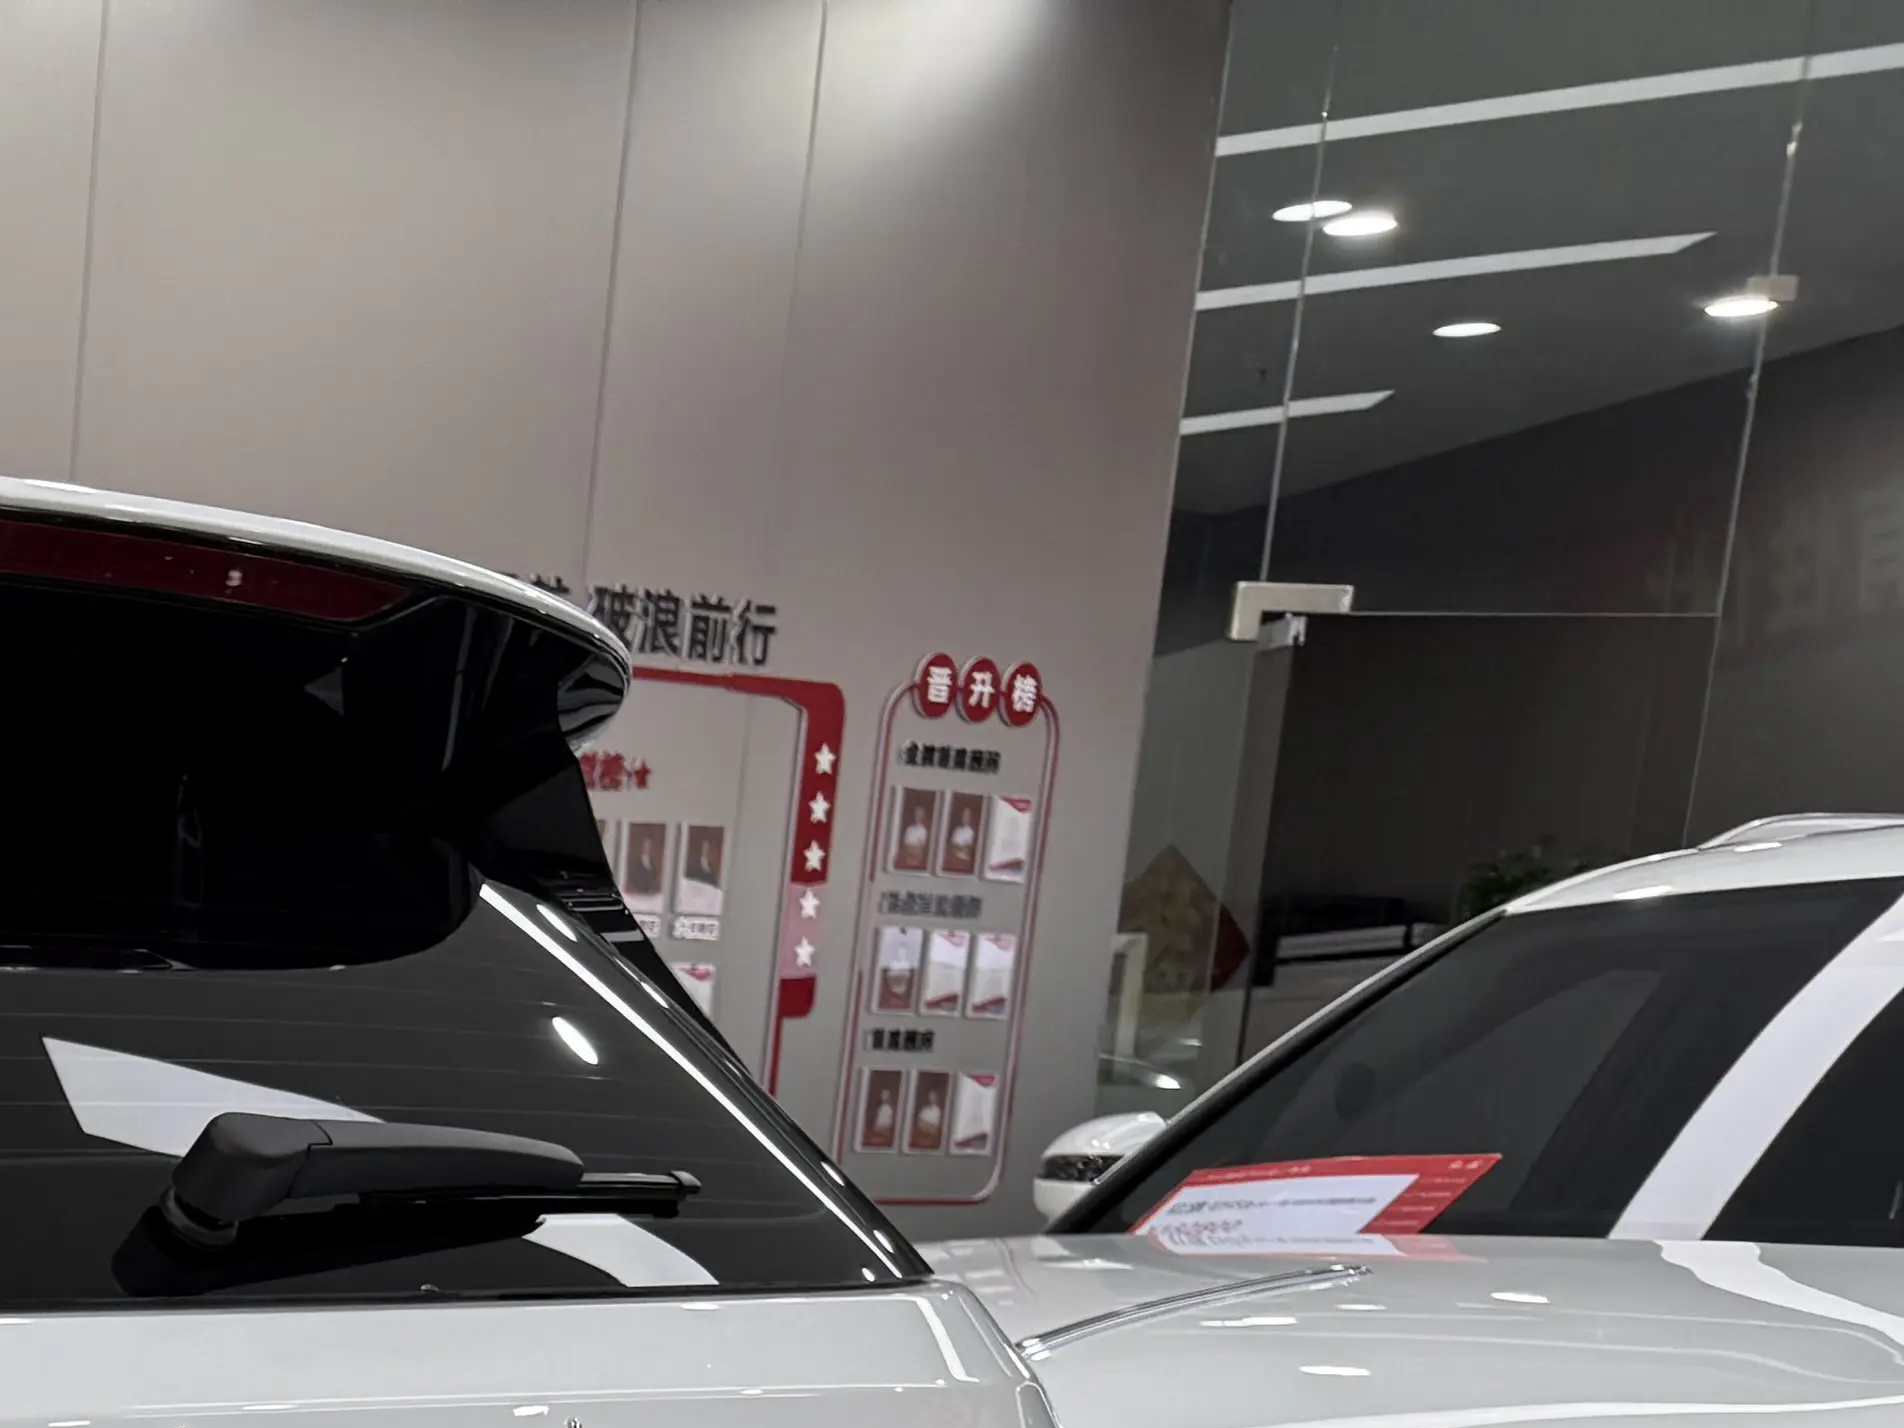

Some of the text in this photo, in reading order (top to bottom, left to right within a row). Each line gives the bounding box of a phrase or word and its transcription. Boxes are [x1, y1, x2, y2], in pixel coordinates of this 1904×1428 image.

[588, 583, 777, 665] 破浪前行
[928, 666, 1037, 713] 晋升榜
